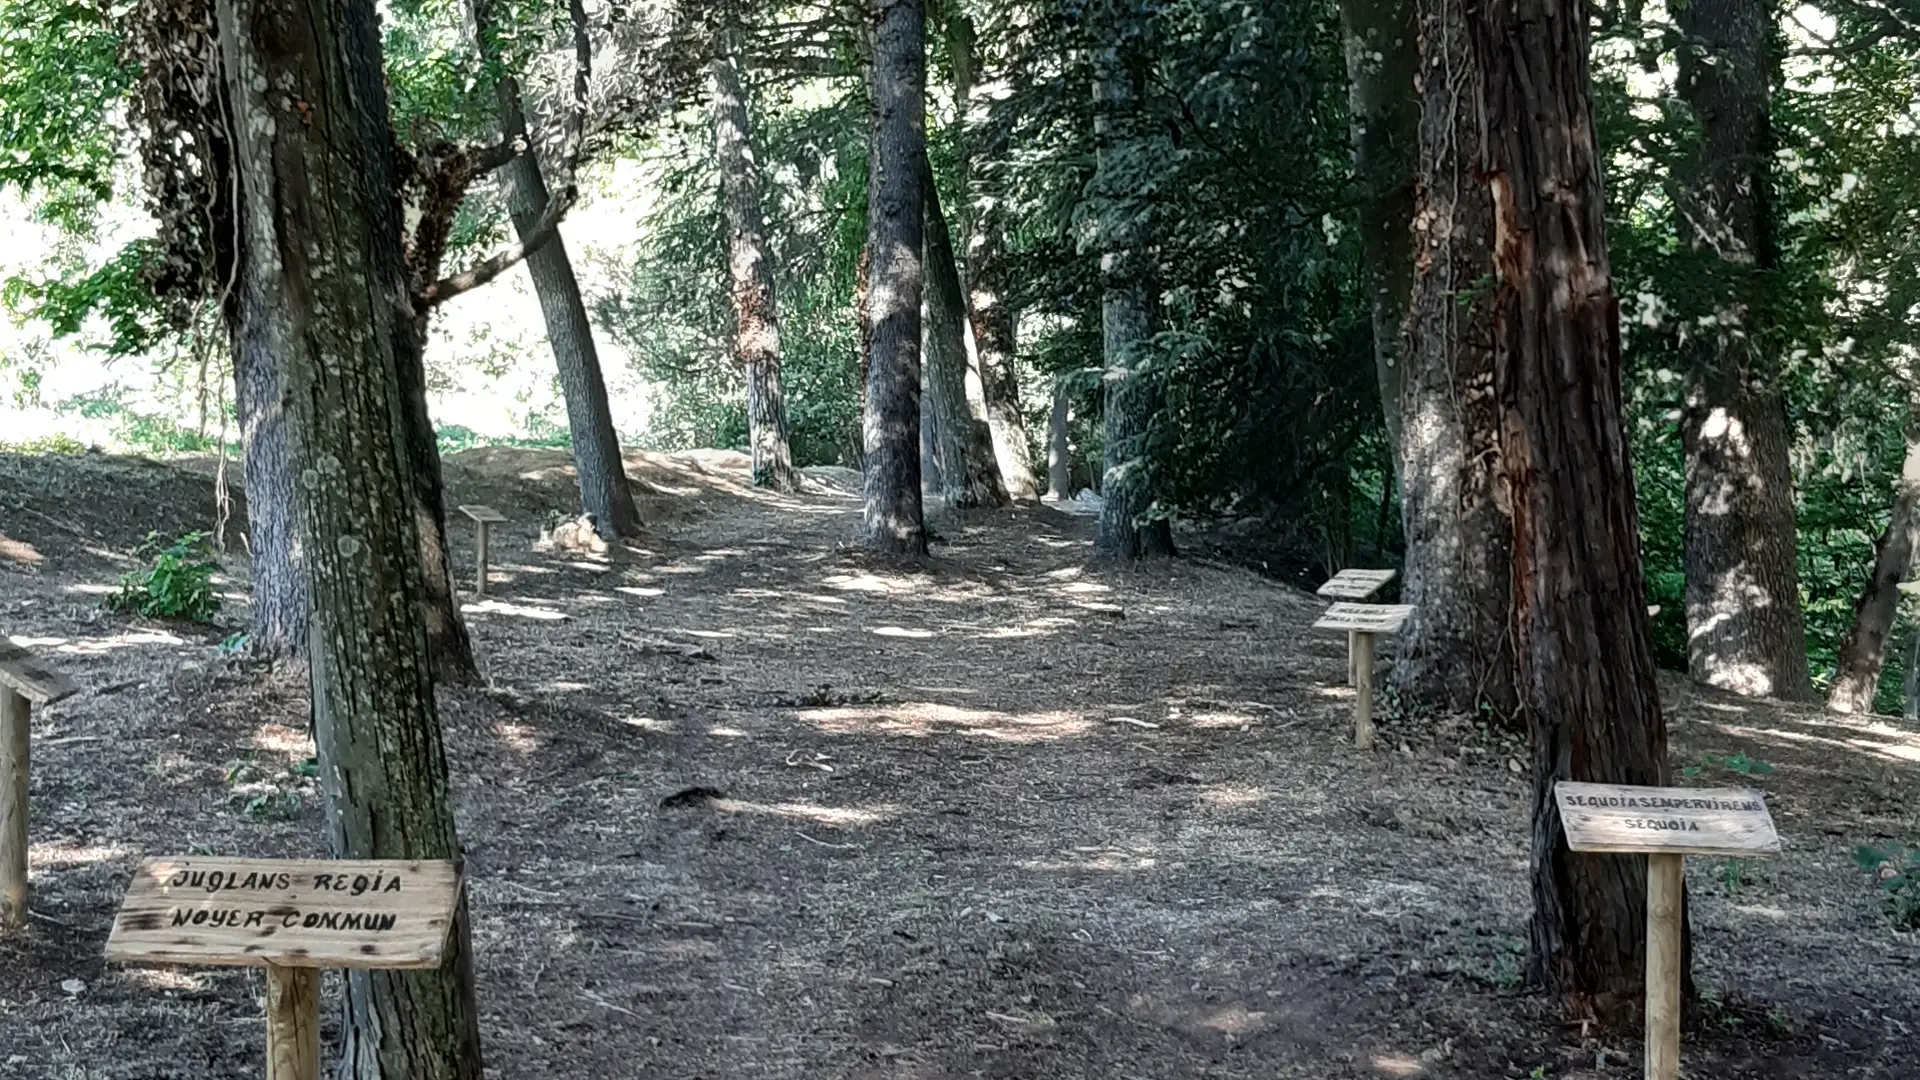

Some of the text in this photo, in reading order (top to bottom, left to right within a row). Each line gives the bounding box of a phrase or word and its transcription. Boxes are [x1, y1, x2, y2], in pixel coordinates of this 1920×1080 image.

[172, 862, 290, 893] JUGLANS
[171, 908, 396, 931] NOYER COMMUN
